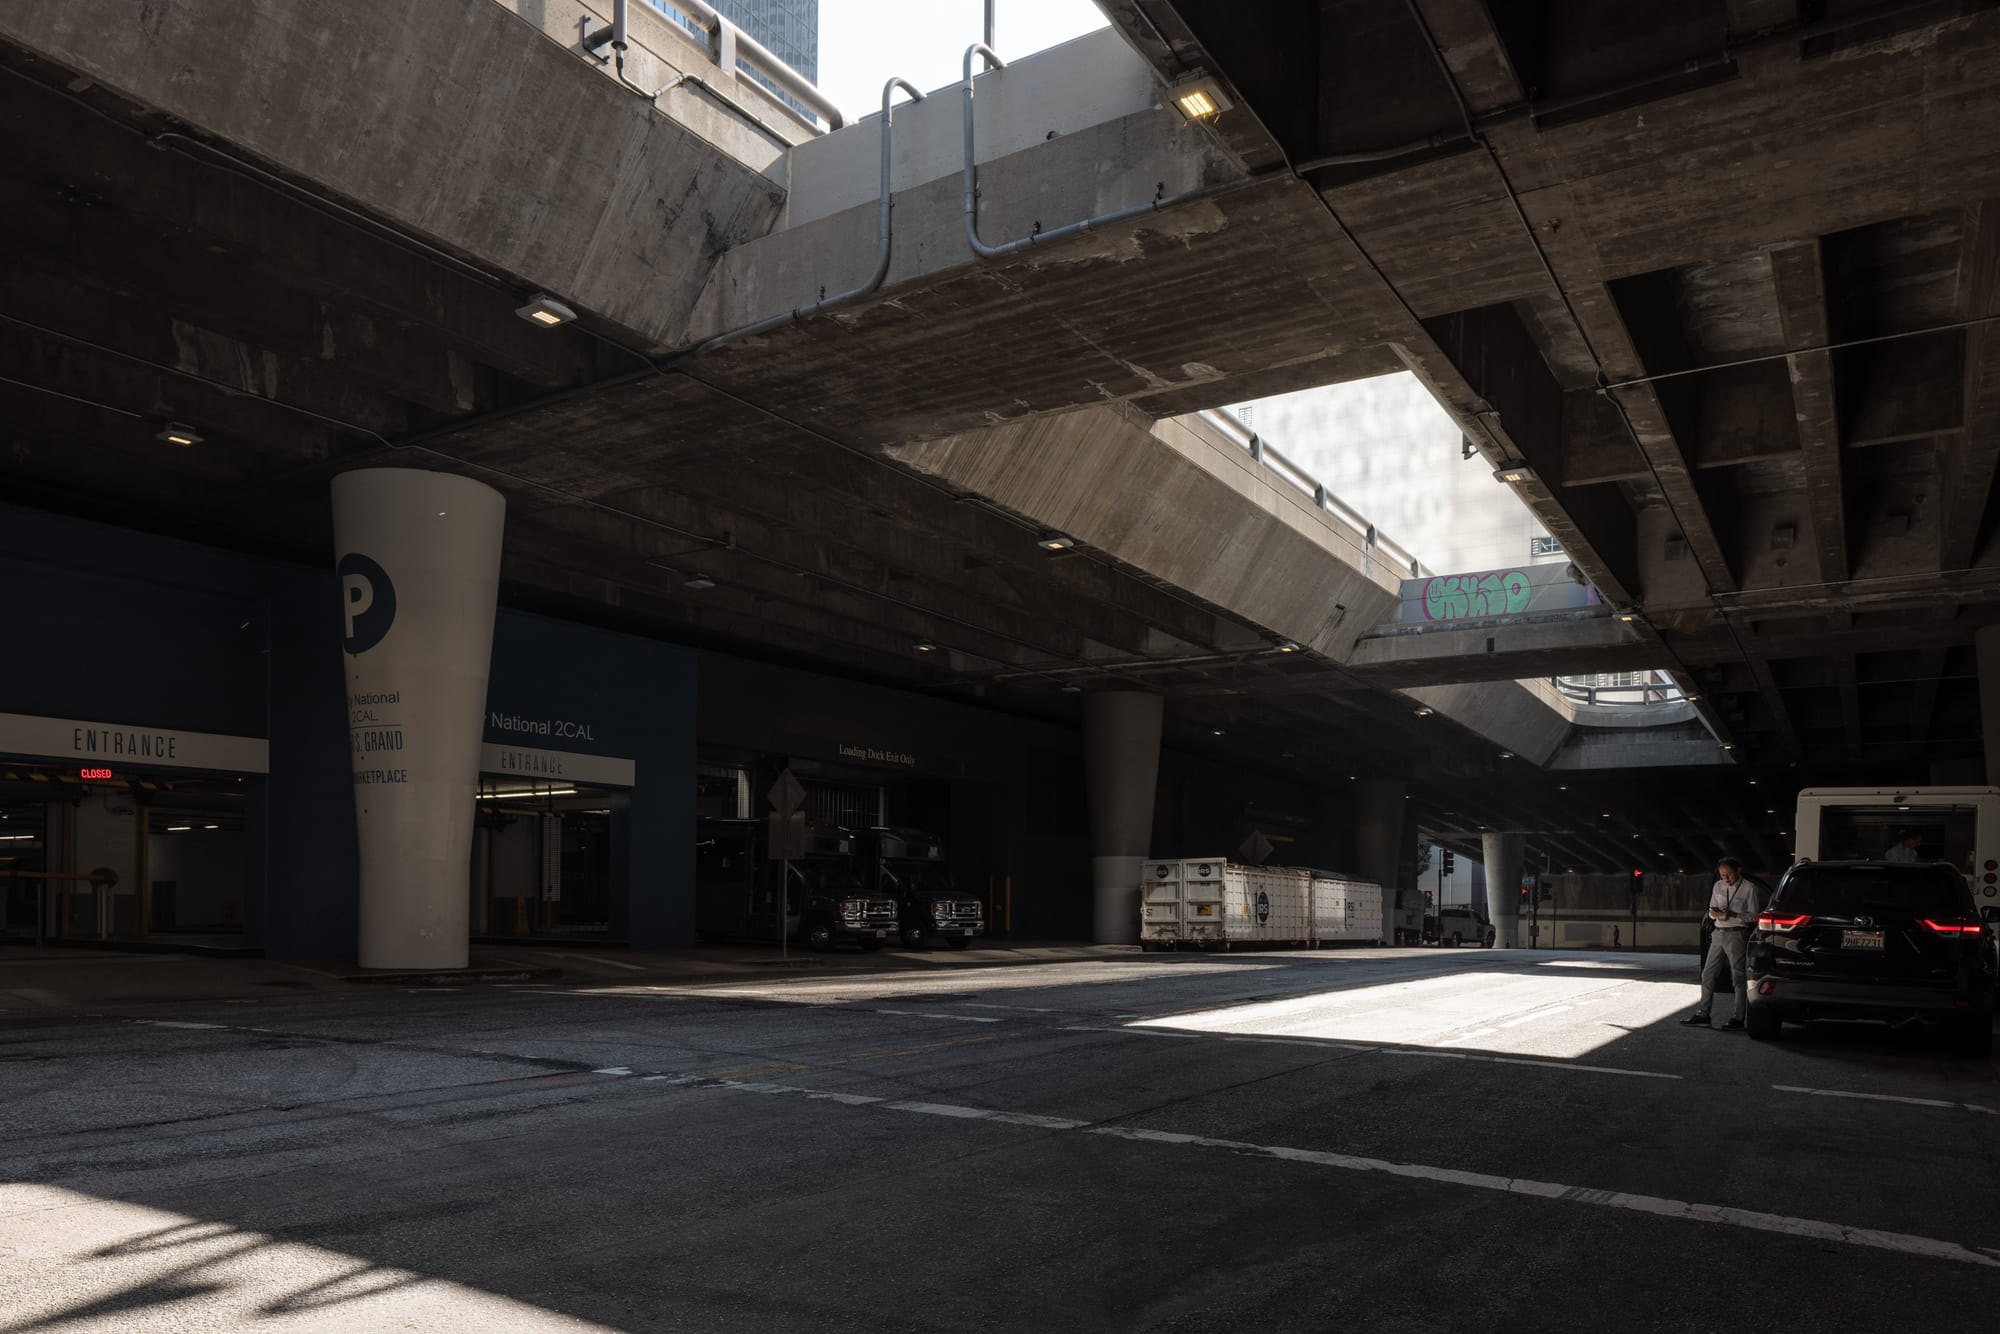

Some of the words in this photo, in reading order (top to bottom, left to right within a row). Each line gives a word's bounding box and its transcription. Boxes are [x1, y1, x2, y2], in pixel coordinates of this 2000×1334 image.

[342, 572, 375, 639] P
[353, 691, 400, 705] National
[491, 711, 551, 735] National
[554, 720, 594, 741] 2CAL
[74, 727, 176, 759] ENTRANCE
[364, 730, 403, 752] GRAND
[501, 751, 563, 774] ENTRANCE
[839, 743, 867, 761] Loading
[867, 748, 885, 761] Dock
[886, 751, 899, 764] Exit
[900, 753, 915, 768] Only
[81, 768, 112, 779] CLOSED
